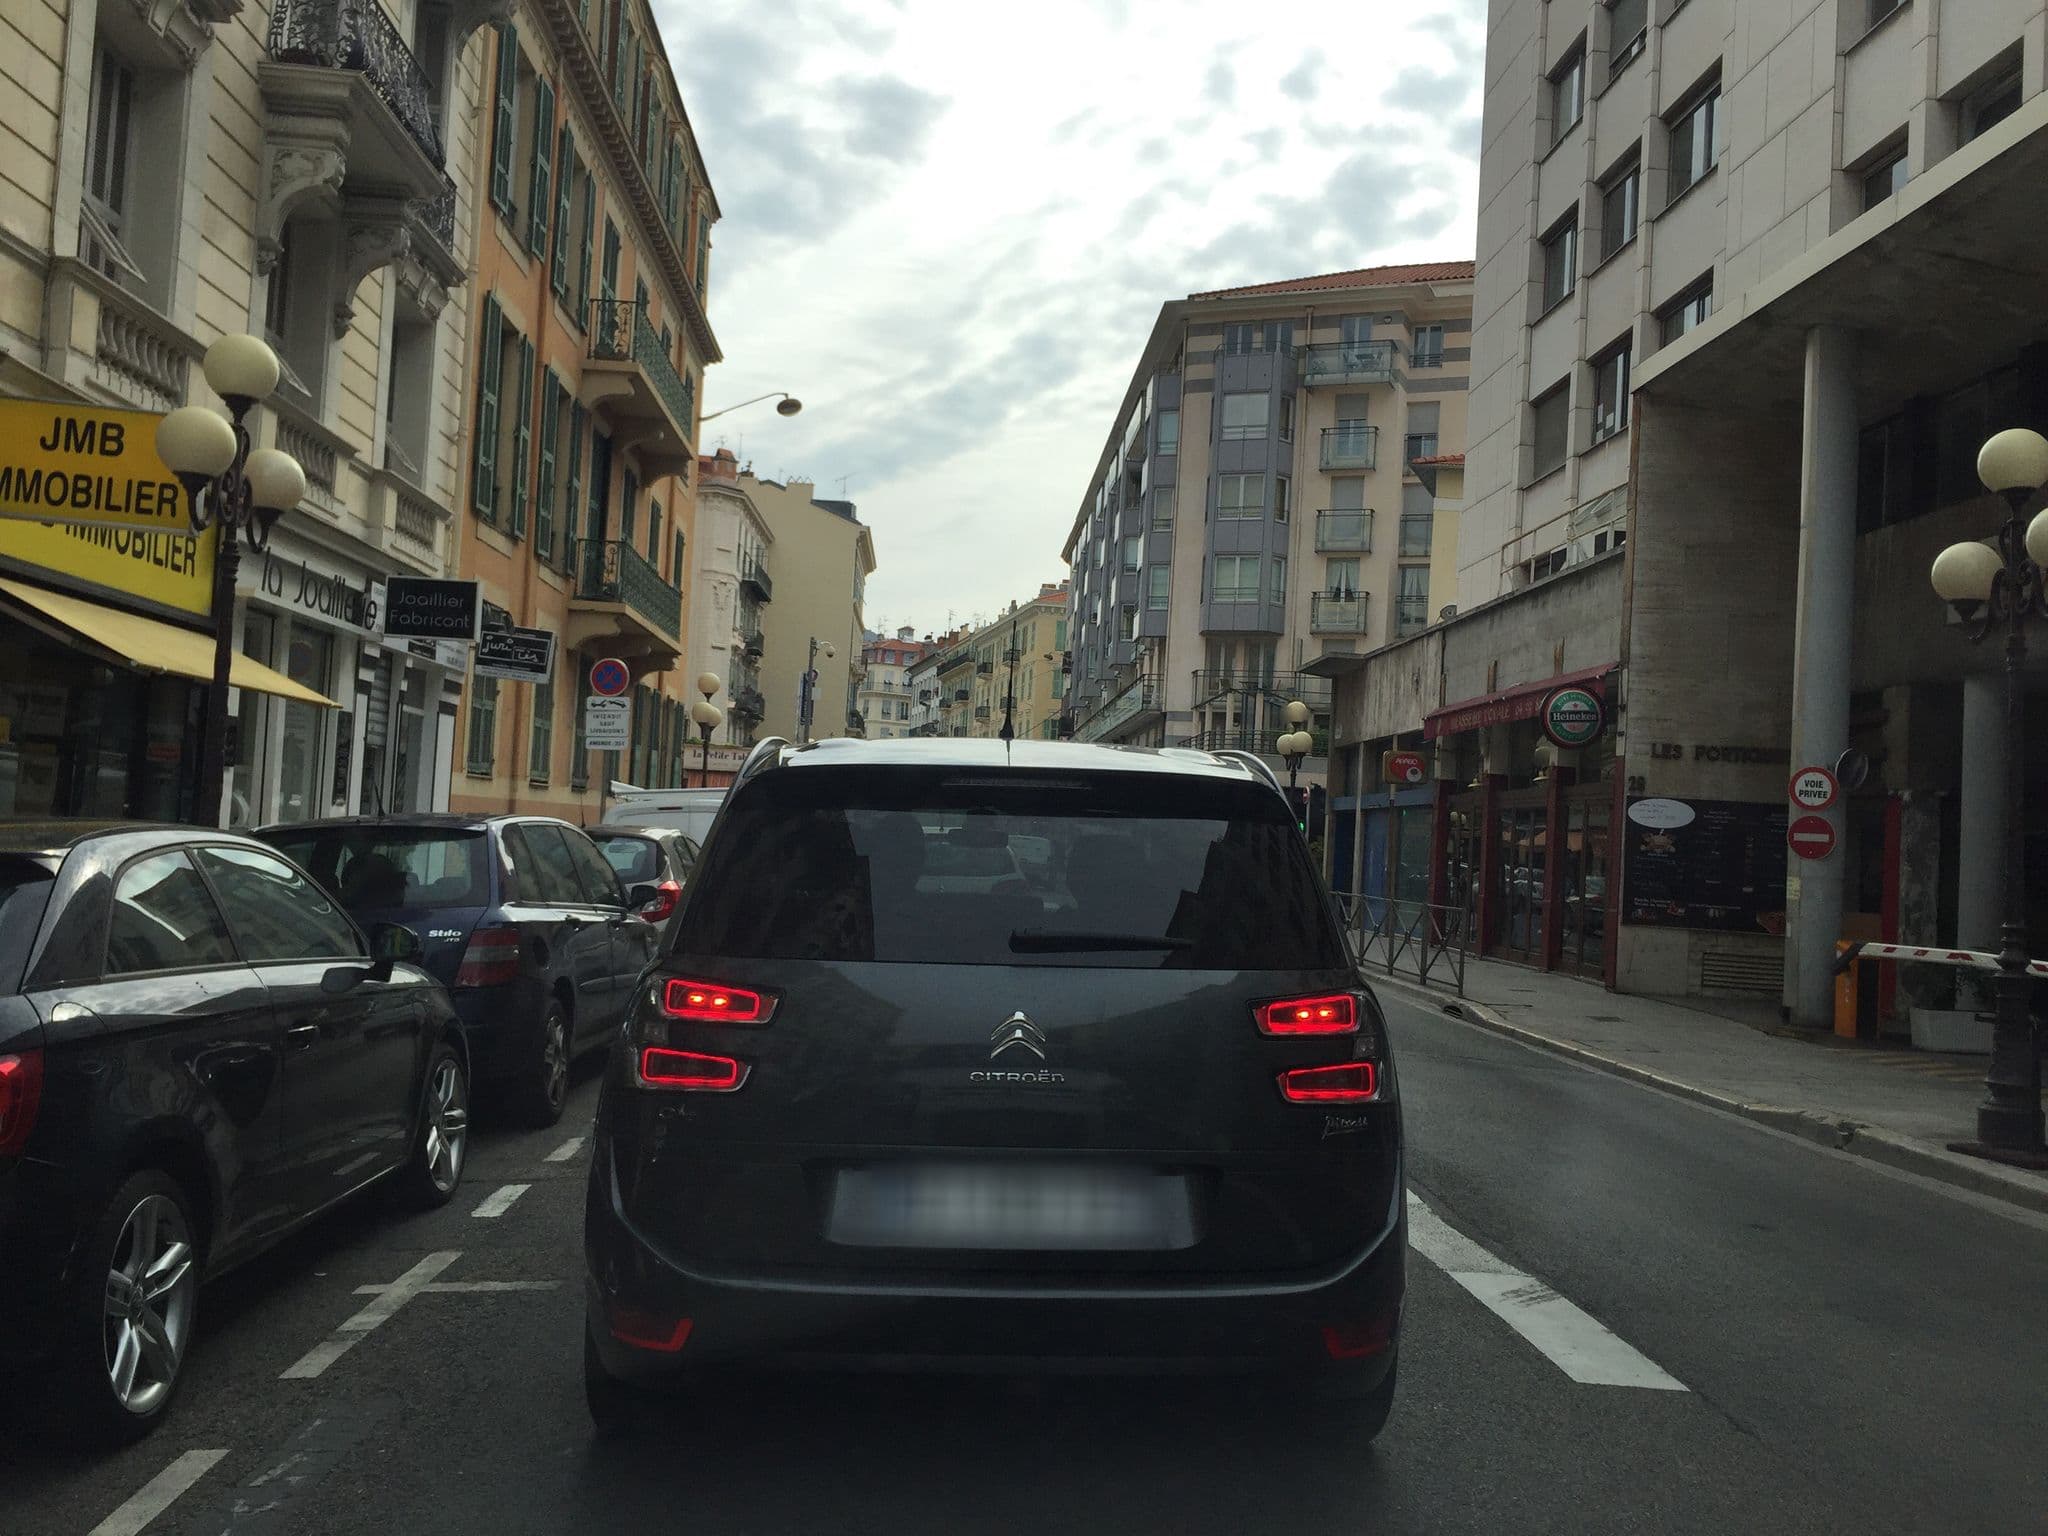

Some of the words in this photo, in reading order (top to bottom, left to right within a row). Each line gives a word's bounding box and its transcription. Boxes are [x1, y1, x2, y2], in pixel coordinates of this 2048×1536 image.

[39, 416, 126, 457] JMB
[261, 546, 283, 598] la
[399, 591, 465, 609] Joaillier
[390, 609, 471, 629] Fabricant
[1553, 711, 1598, 722] Heineken
[1804, 779, 1824, 789] VOIE
[428, 929, 463, 938] Stilo
